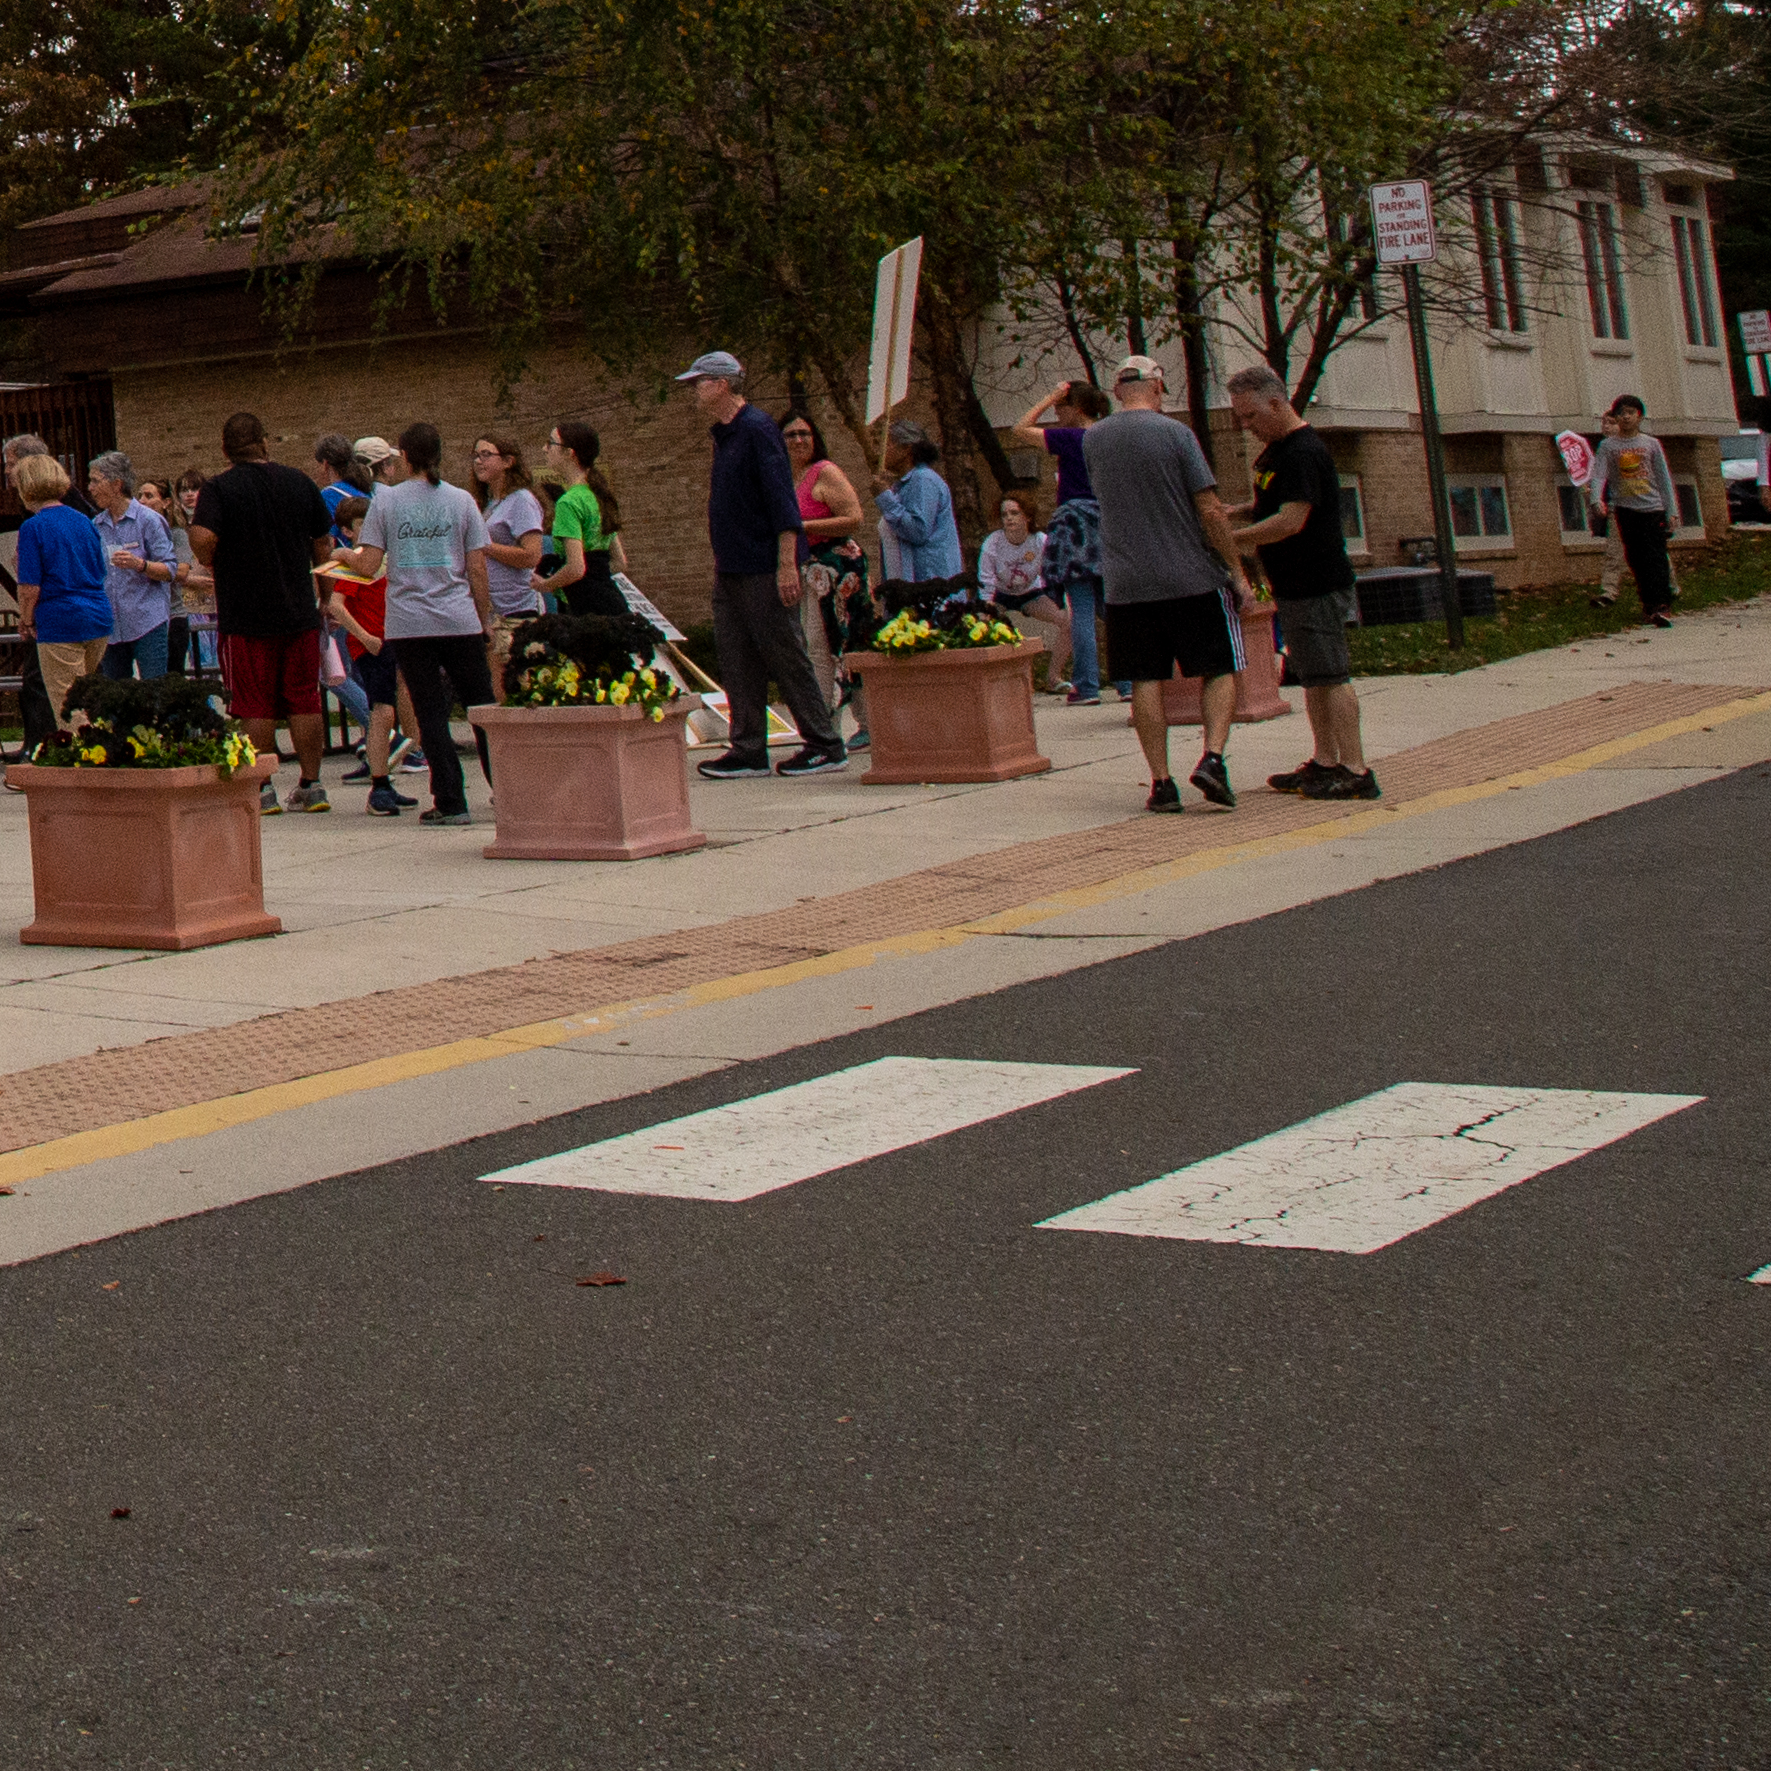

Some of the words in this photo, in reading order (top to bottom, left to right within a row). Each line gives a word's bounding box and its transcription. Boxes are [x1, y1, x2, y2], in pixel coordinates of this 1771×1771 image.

[1391, 187, 1405, 198] NO
[1379, 199, 1421, 213] PARKING
[1378, 219, 1427, 233] STANDING
[1379, 235, 1401, 249] FIRE
[1403, 232, 1430, 246] LANE
[397, 521, 452, 540] Grateful
